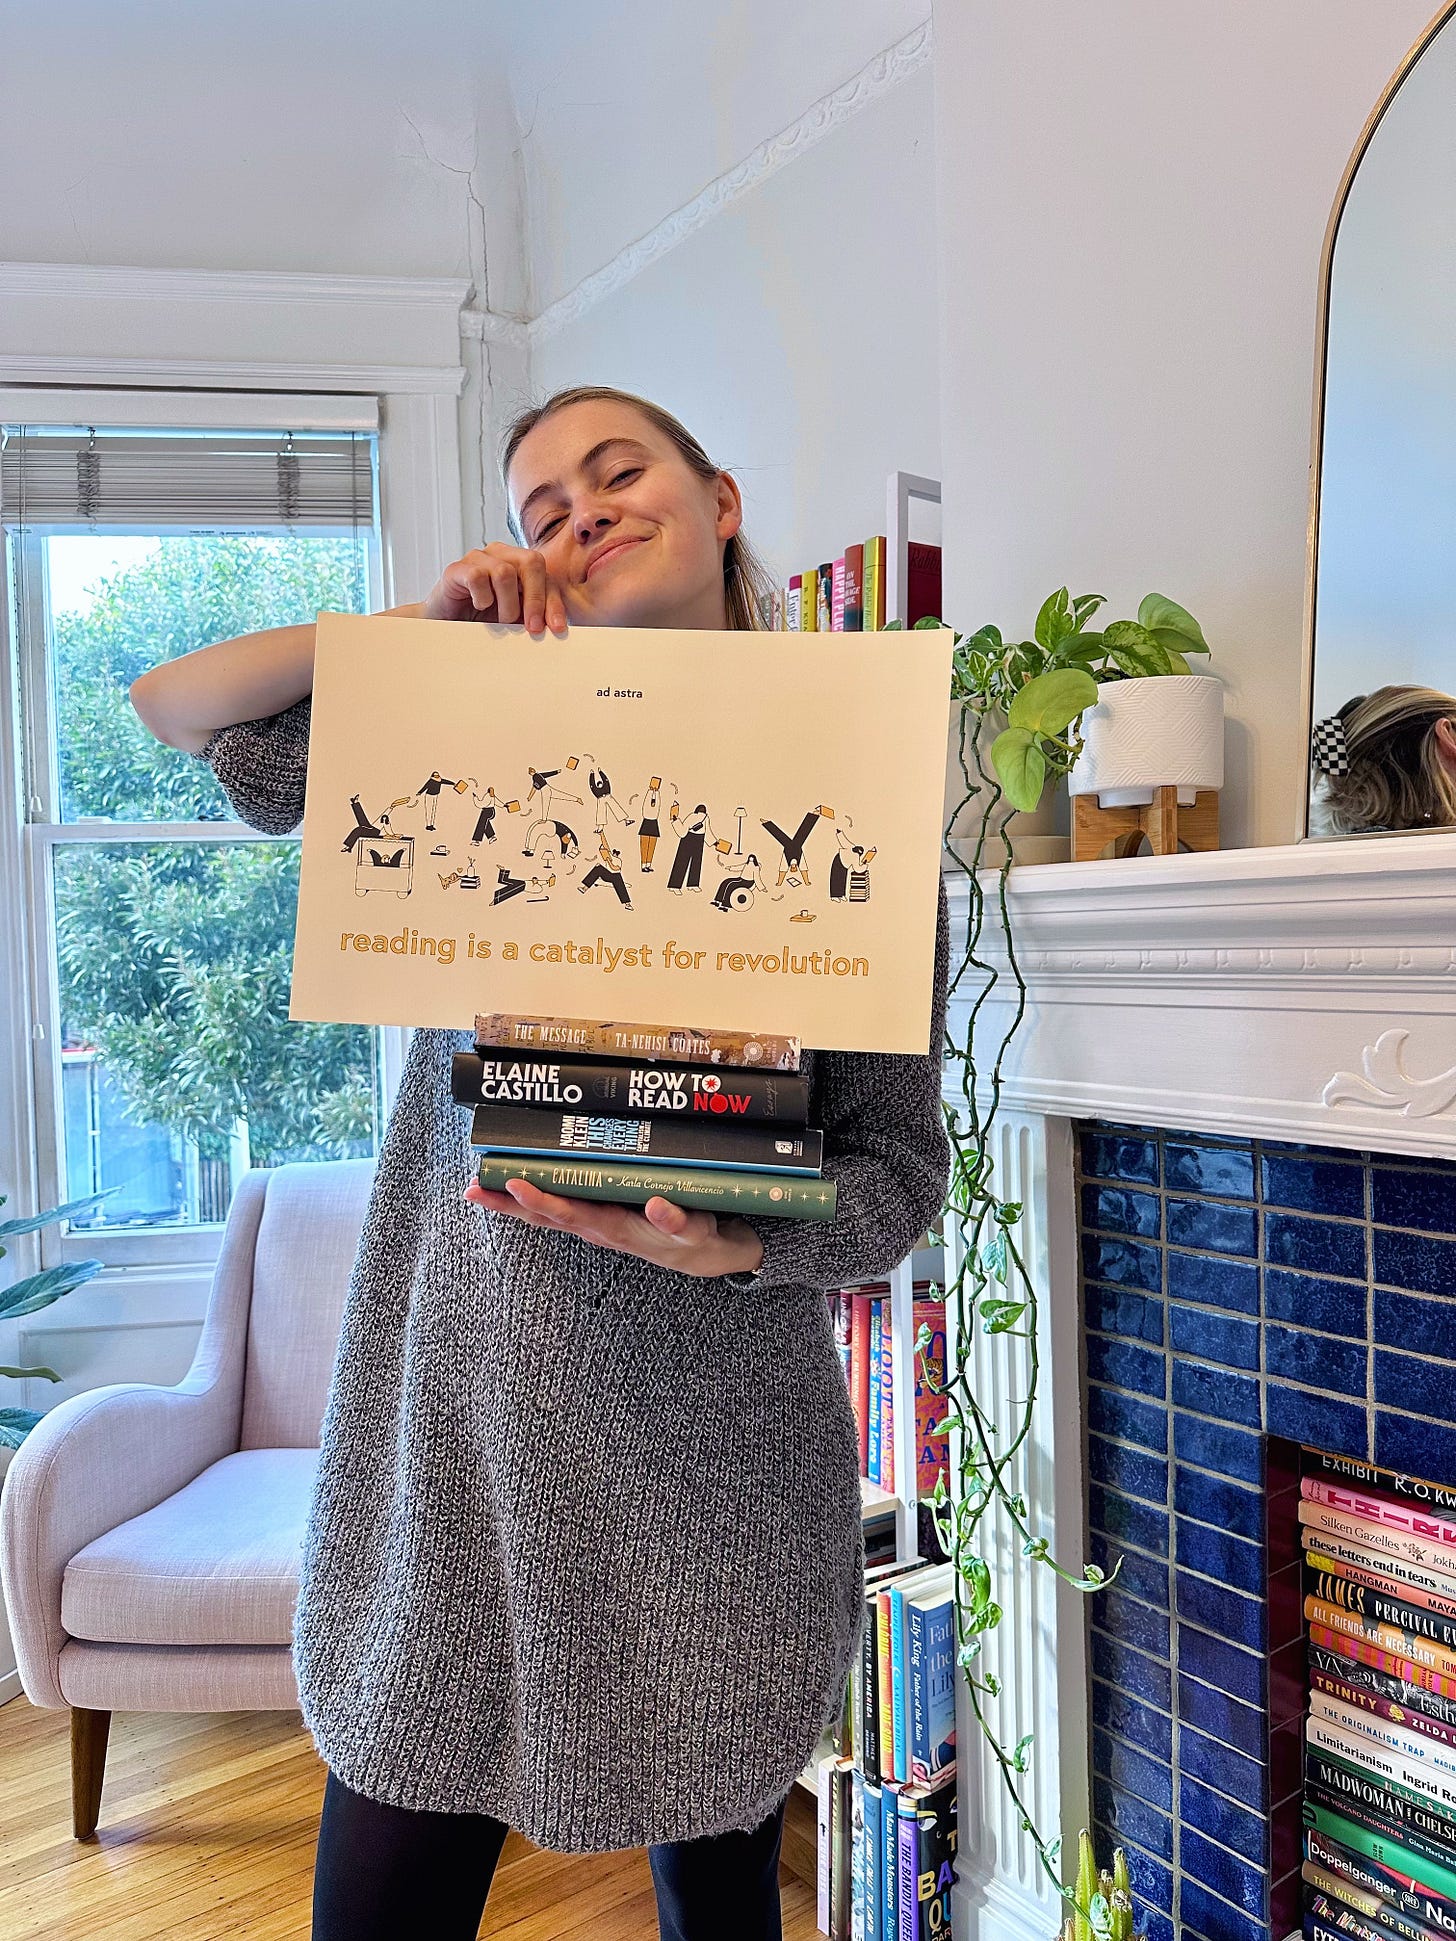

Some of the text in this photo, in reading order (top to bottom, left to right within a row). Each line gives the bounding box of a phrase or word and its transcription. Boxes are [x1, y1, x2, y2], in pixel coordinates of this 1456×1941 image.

[596, 686, 642, 698] ad astra
[340, 927, 869, 976] reading is a catalyst for revolution
[514, 1024, 712, 1056] THE MESSAGE TA-NEHISI COATES
[482, 1061, 561, 1084] ELAINE
[610, 1076, 618, 1098] VIKING
[629, 1070, 687, 1091] HOW
[690, 1074, 722, 1094] TO
[481, 1080, 583, 1104] CASTILLO
[628, 1088, 752, 1114] READ NOW
[560, 1115, 576, 1147] NAOMI
[572, 1116, 590, 1148] KLEIN
[586, 1118, 606, 1148] THIS
[602, 1118, 615, 1150] CHANGES
[612, 1118, 627, 1151] EVERY
[624, 1120, 640, 1152] THING
[552, 1167, 725, 1195] CATALINA Karla Cornejo Villavicencio
[881, 1333, 893, 1410] LOOT
[870, 1381, 880, 1464] Family Lore
[1320, 1514, 1352, 1534] Silken
[1354, 1527, 1400, 1550] Gazelles
[1309, 1536, 1438, 1588] these letters end in tears
[1346, 1568, 1398, 1594] HANGMAN
[1316, 1572, 1365, 1614] JAMES
[1375, 1600, 1438, 1639] PERCIVAL
[910, 1614, 921, 1638] Lily
[1312, 1606, 1328, 1622] ALL
[1330, 1612, 1364, 1638] FRIENDS
[1366, 1628, 1383, 1646] ARE
[1385, 1636, 1436, 1667] NECESSARY
[867, 1662, 873, 1676] BY
[911, 1639, 922, 1667] King
[930, 1650, 953, 1672] the
[866, 1676, 874, 1718] AMERICA
[914, 1672, 922, 1698] Father
[1316, 1676, 1448, 1741] TRINITY ZELDA
[914, 1722, 922, 1742] Rain
[1323, 1706, 1338, 1720] THE
[1342, 1715, 1399, 1747] ORIGINALISM
[1402, 1742, 1425, 1757] TRAP
[1316, 1730, 1393, 1774] Limitarianism
[1402, 1770, 1438, 1796] Ingrid
[1320, 1764, 1404, 1819] MADWOMAN
[886, 1809, 895, 1834] Man
[1317, 1792, 1330, 1801] THE
[1330, 1798, 1362, 1818] VOLCANO
[1363, 1814, 1404, 1840] DAUGHTERS
[886, 1835, 895, 1862] Made
[902, 1842, 912, 1867] THE
[886, 1862, 895, 1910] Monsters
[902, 1865, 912, 1911] BANDIT
[1311, 1842, 1397, 1897] Doppelganger
[1426, 1900, 1456, 1933] Na
[1313, 1876, 1332, 1892] THE
[1334, 1886, 1377, 1917] WITCHES
[1380, 1912, 1395, 1927] OF
[1312, 1894, 1335, 1922] The
